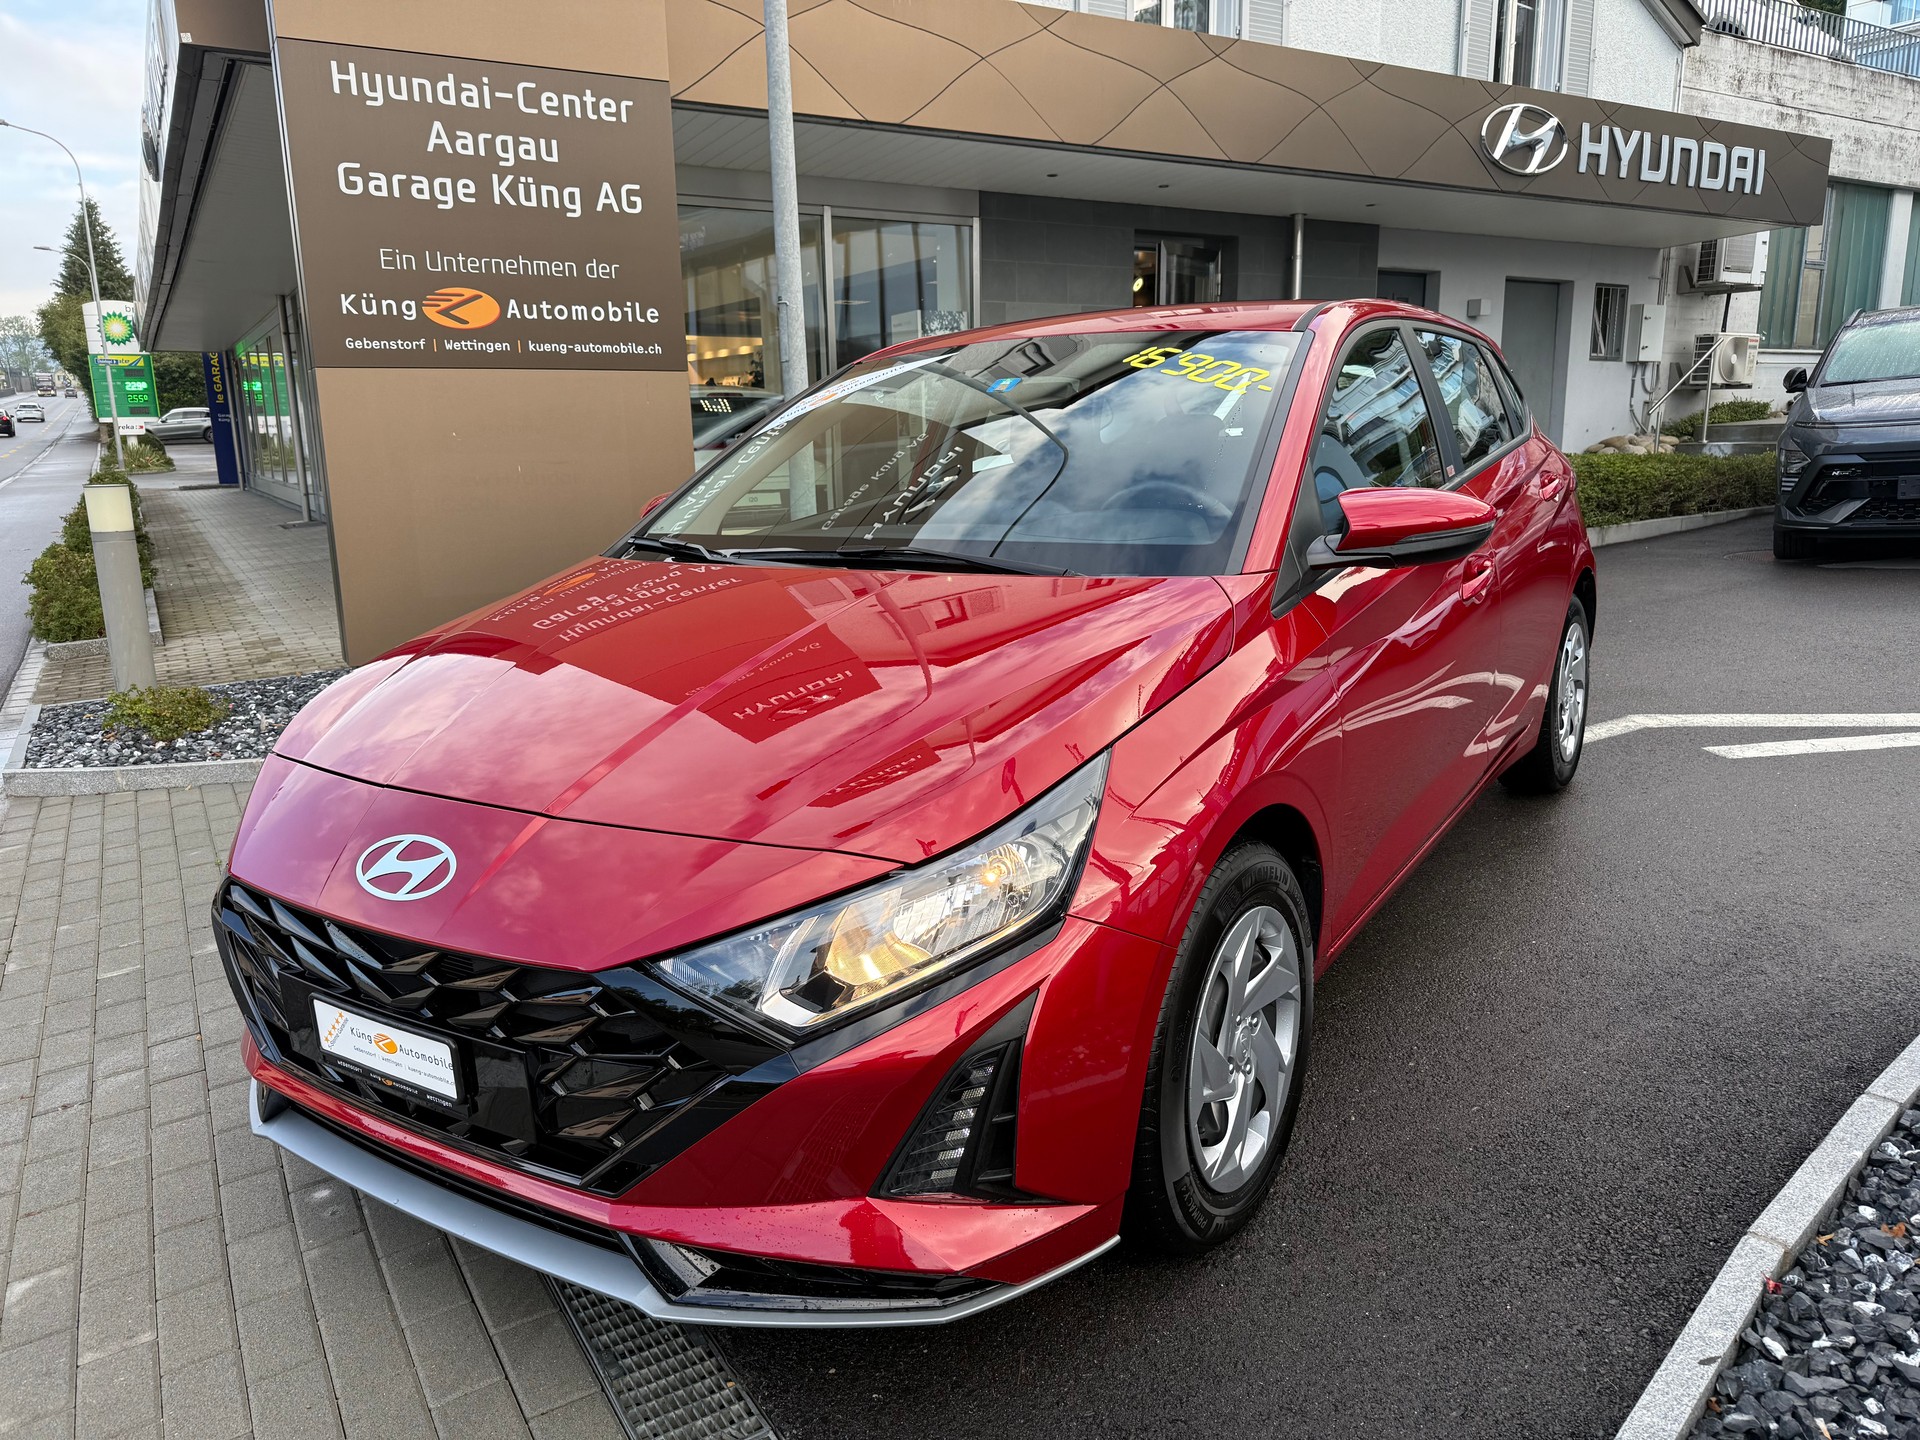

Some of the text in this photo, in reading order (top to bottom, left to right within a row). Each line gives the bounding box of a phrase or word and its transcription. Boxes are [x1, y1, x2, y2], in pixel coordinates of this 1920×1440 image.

[330, 60, 634, 123] Hyundai-Center
[427, 120, 559, 166] Aargau
[1577, 121, 1766, 195] HYUNDAI
[337, 161, 643, 217] Garage Küng AG
[380, 248, 620, 279] Ein Unternehmen der
[340, 293, 660, 324] Küng Automobile
[345, 337, 663, 355] Gebenstorf Wettingen kueng-automobile.ch
[209, 352, 222, 392] GARAG
[350, 1026, 454, 1071] Küng Automobile
